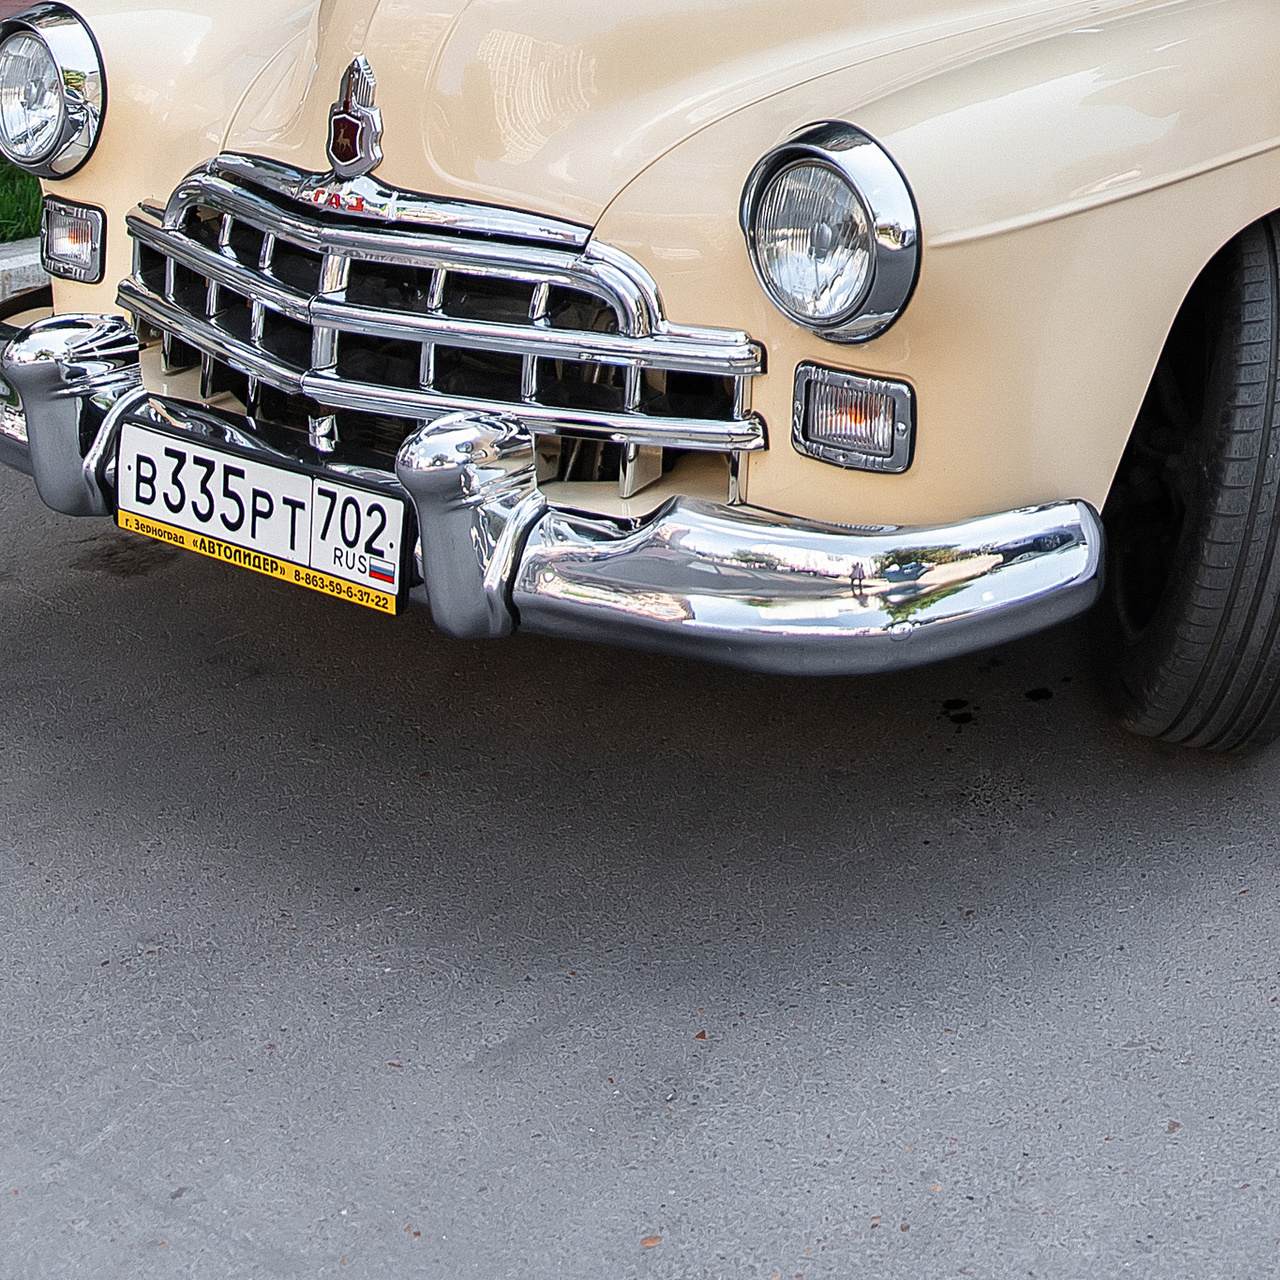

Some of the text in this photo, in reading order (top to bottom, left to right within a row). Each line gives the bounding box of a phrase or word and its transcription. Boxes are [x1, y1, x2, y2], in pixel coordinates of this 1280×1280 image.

[317, 486, 387, 558] 702
[134, 518, 186, 546] Зерноград
[294, 569, 389, 610] 8-863-59-6-37-22
[333, 546, 367, 575] RUS
